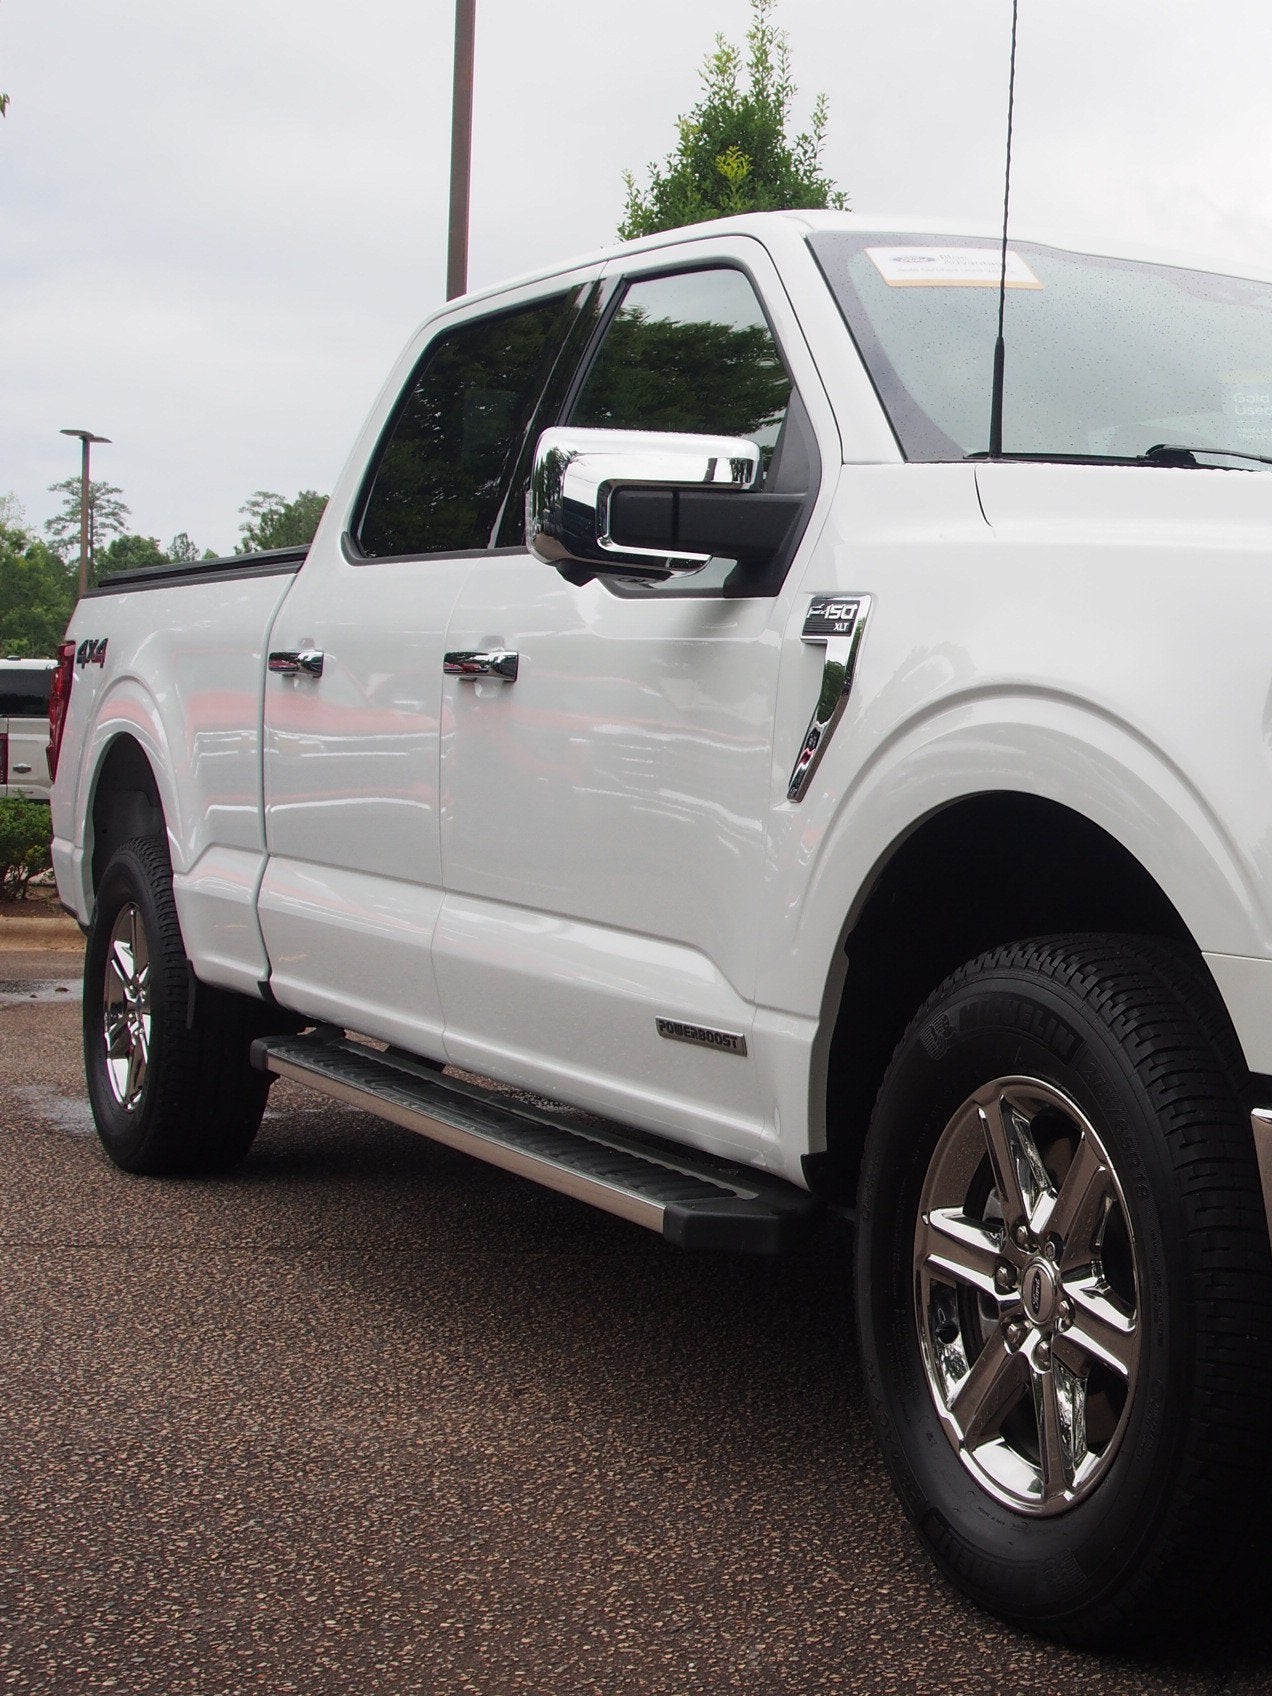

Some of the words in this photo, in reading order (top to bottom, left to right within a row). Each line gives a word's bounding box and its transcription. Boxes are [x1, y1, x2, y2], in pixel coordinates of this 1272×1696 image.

[1233, 392, 1270, 404] Gold
[806, 603, 858, 619] F-150
[833, 622, 850, 631] XLT
[658, 1019, 738, 1049] POWERBOOST
[955, 999, 1076, 1063] MICHELIN
[1032, 1277, 1041, 1309] Ford
